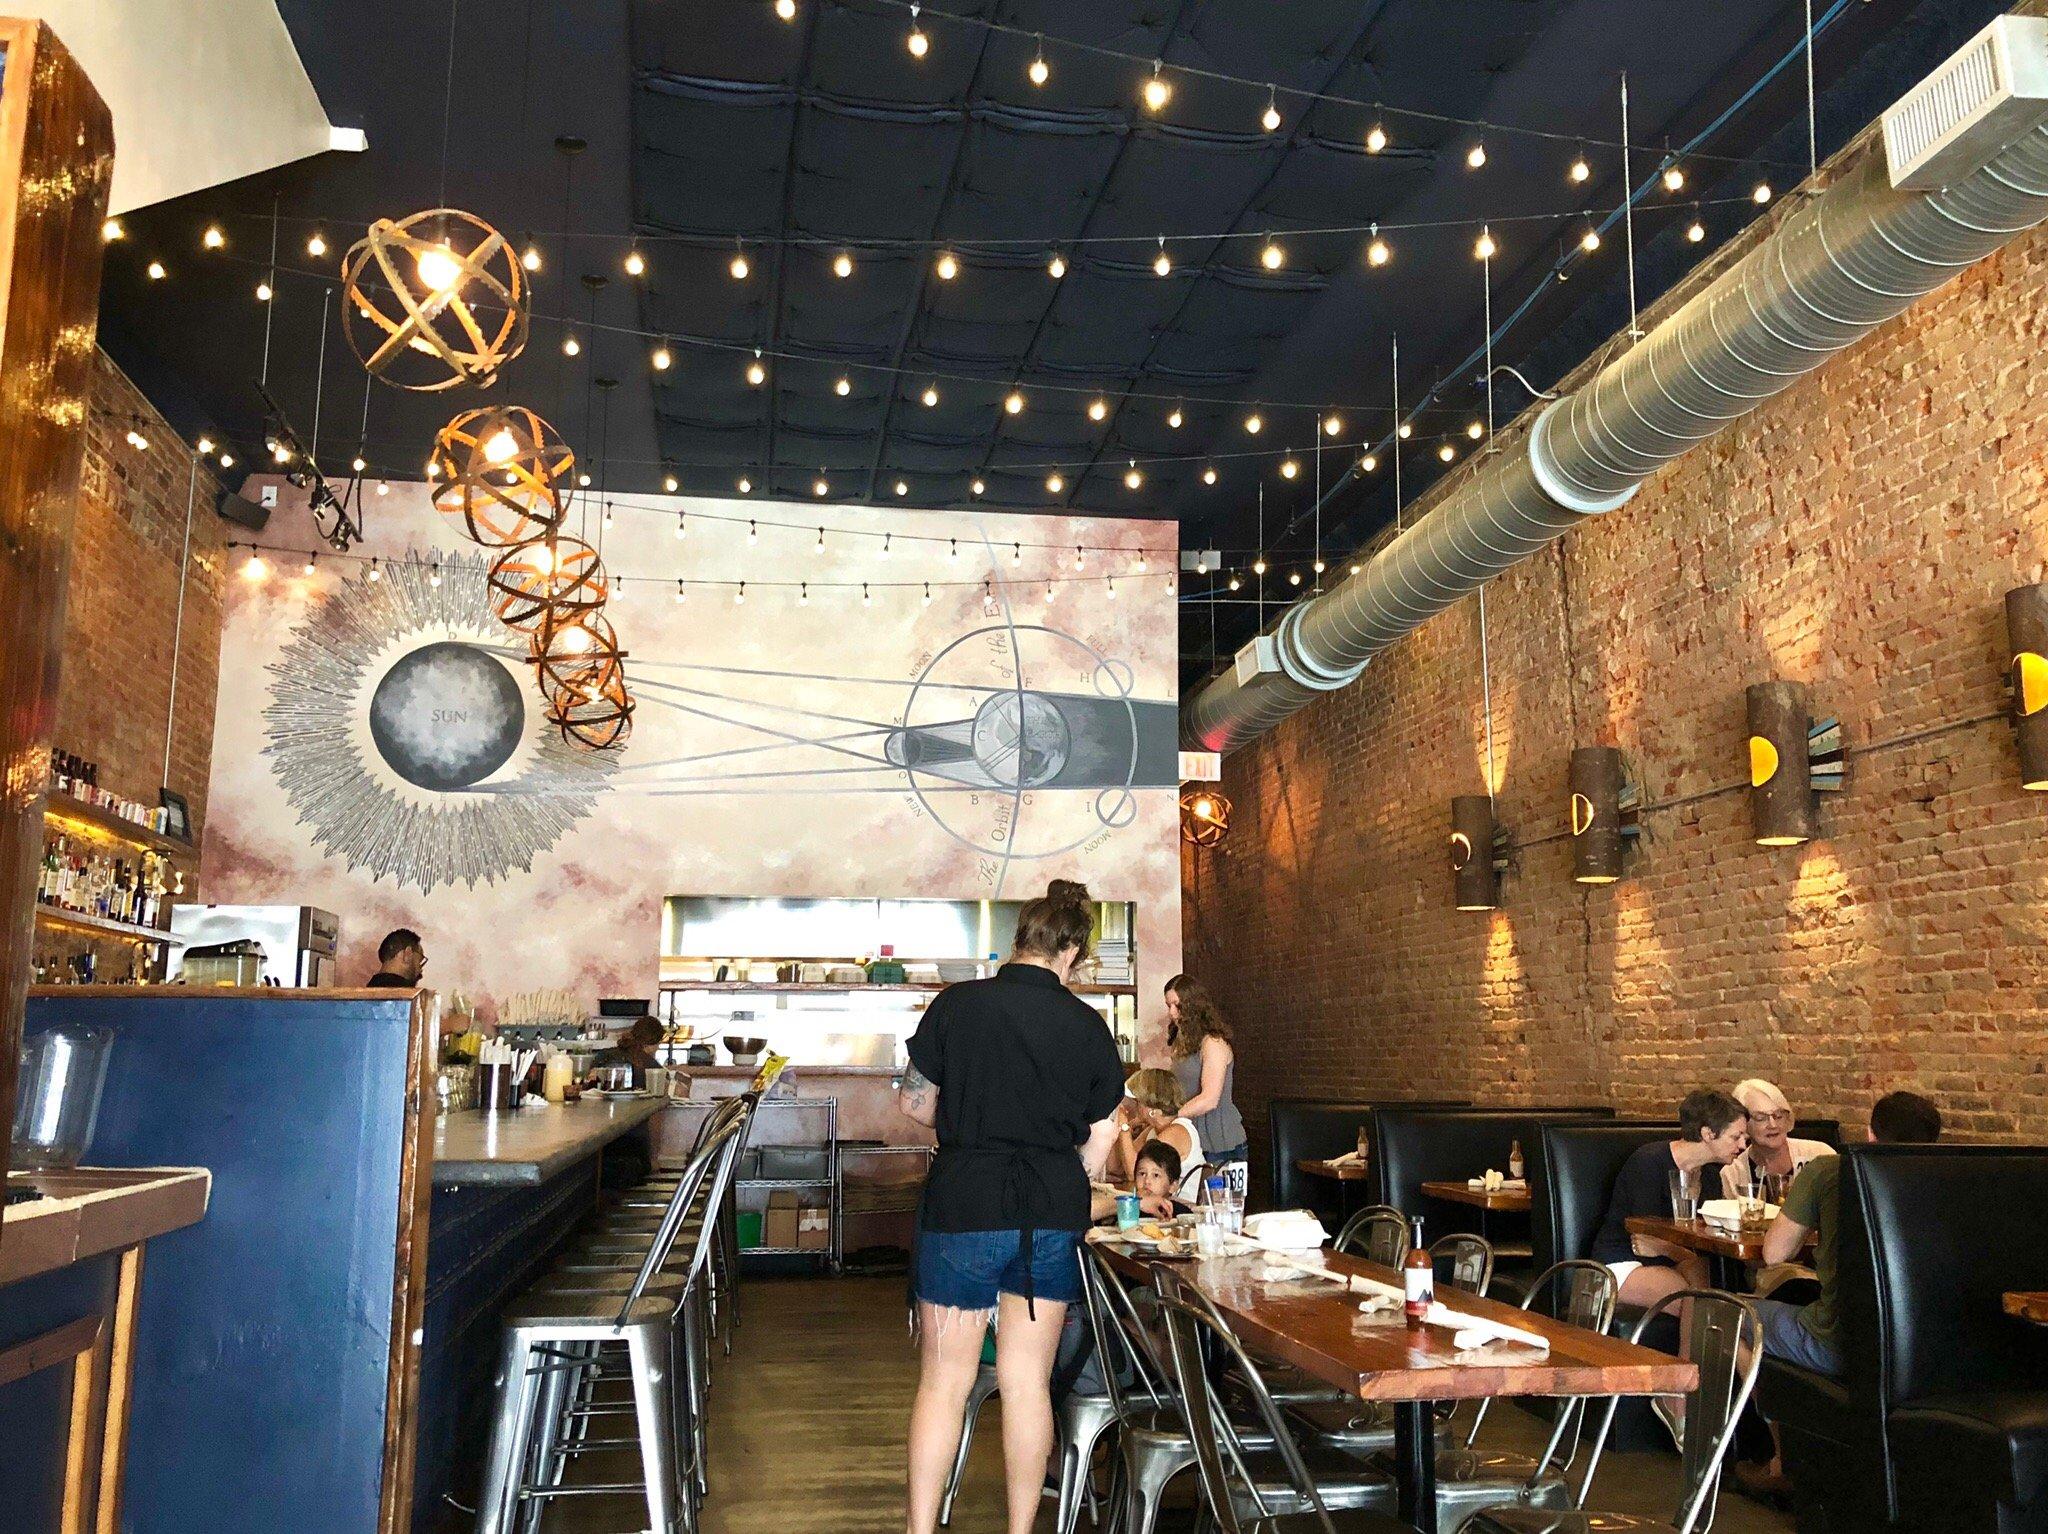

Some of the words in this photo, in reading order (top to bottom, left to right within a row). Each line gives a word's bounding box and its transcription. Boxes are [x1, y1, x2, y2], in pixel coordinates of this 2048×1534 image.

[986, 633, 1008, 655] the
[908, 651, 932, 679] MOON
[990, 659, 1014, 679] of
[1024, 677, 1033, 688] F
[1080, 672, 1090, 683] H
[969, 696, 978, 707] A
[431, 709, 467, 723] SUN
[893, 717, 902, 725] M
[977, 730, 985, 741] C
[970, 794, 979, 805] B
[1022, 794, 1033, 806] G
[1086, 801, 1091, 813] I
[991, 804, 1011, 842] Orbit
[1083, 829, 1112, 855] MOON
[977, 857, 998, 886] The
